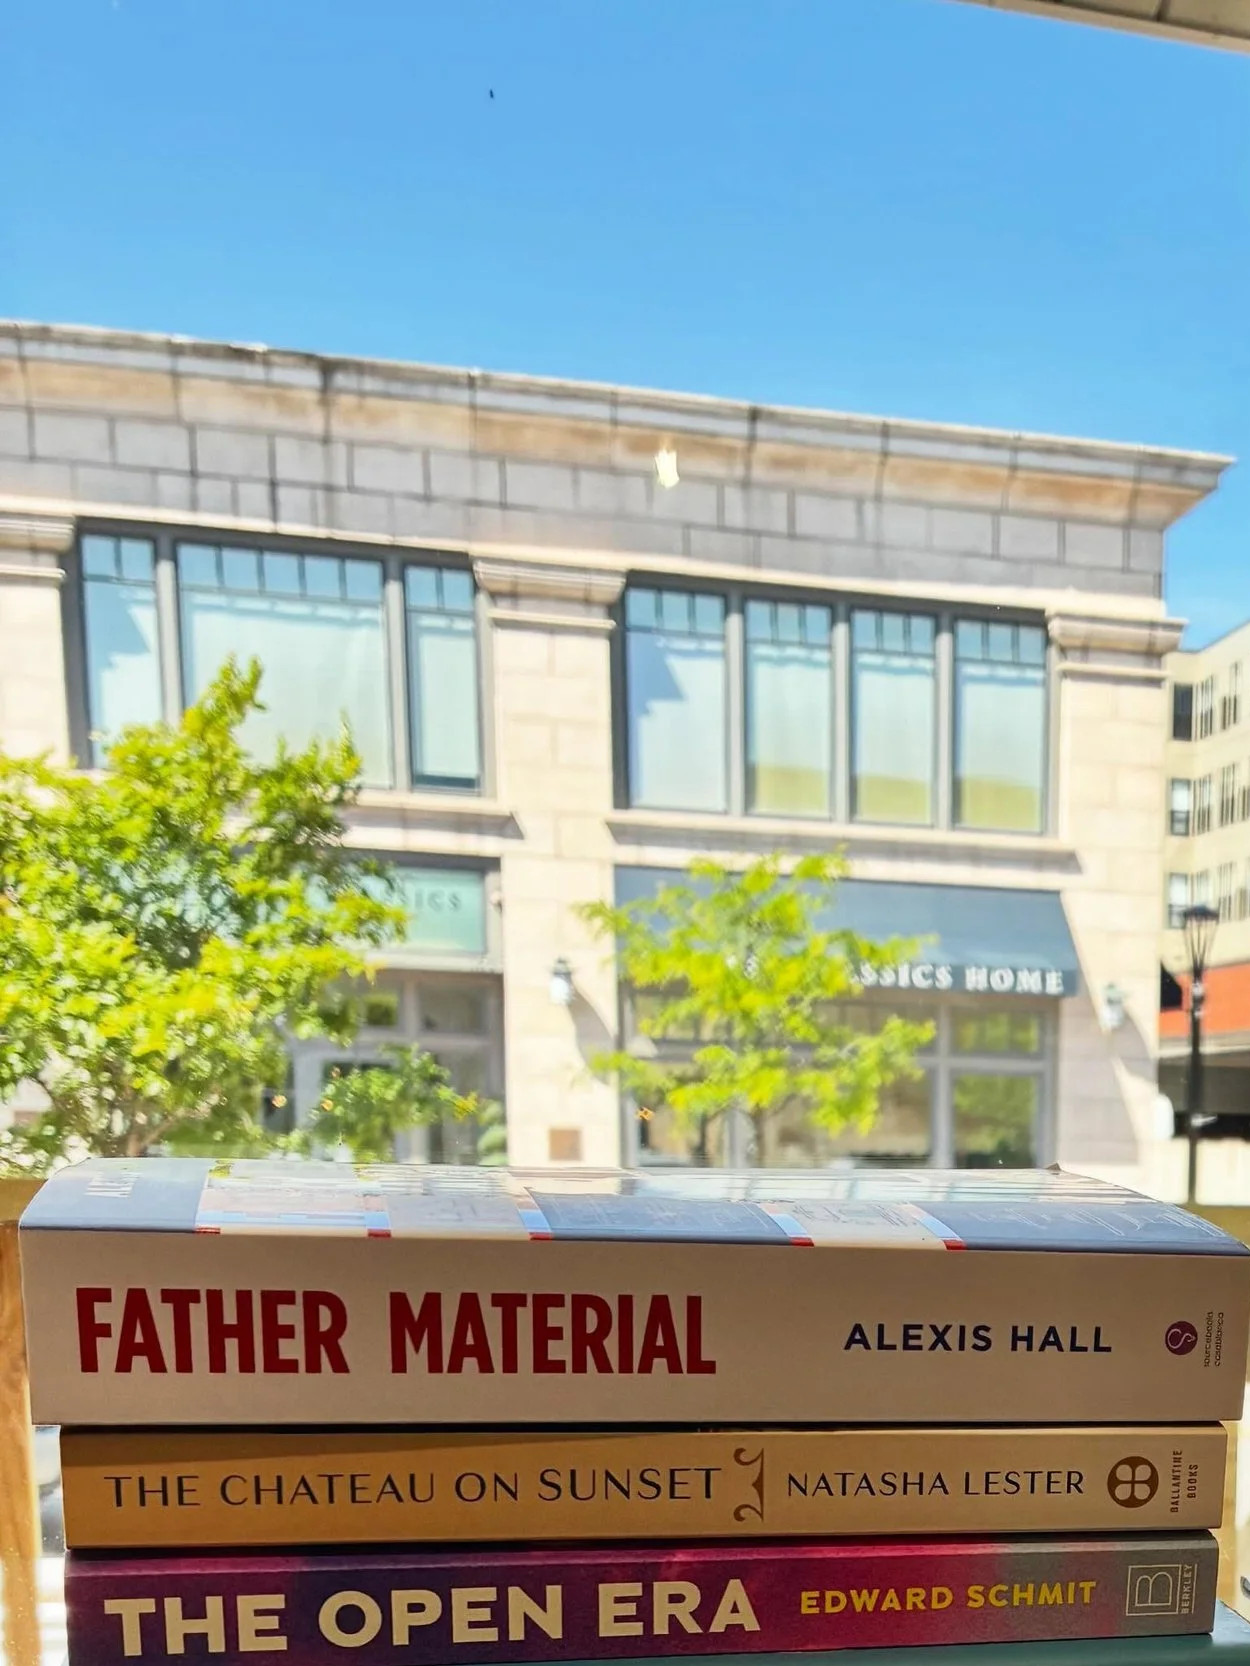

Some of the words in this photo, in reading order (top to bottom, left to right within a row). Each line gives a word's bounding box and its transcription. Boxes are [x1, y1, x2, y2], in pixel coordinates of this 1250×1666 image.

[965, 965, 1064, 994] HOME
[75, 1287, 350, 1374] FATHER
[389, 1291, 717, 1375] MATERIAL
[844, 1323, 992, 1351] ALEXIS
[1011, 1325, 1112, 1353] HALL
[105, 1476, 201, 1507] THE
[220, 1472, 435, 1505] CHATEAU
[455, 1471, 519, 1502] ON
[538, 1467, 722, 1501] SUNSET
[787, 1471, 949, 1497] NATASHA
[964, 1470, 1084, 1496] LESTER
[1170, 1450, 1182, 1513] BALLANTINE
[1187, 1464, 1199, 1499] BOOKS
[801, 1586, 954, 1615] EDWARD
[967, 1580, 1098, 1608] SCHMIT
[1181, 1564, 1193, 1614] BERKLEY
[104, 1594, 288, 1657] THE
[319, 1583, 562, 1649] OPEN
[599, 1578, 761, 1638] ERA
